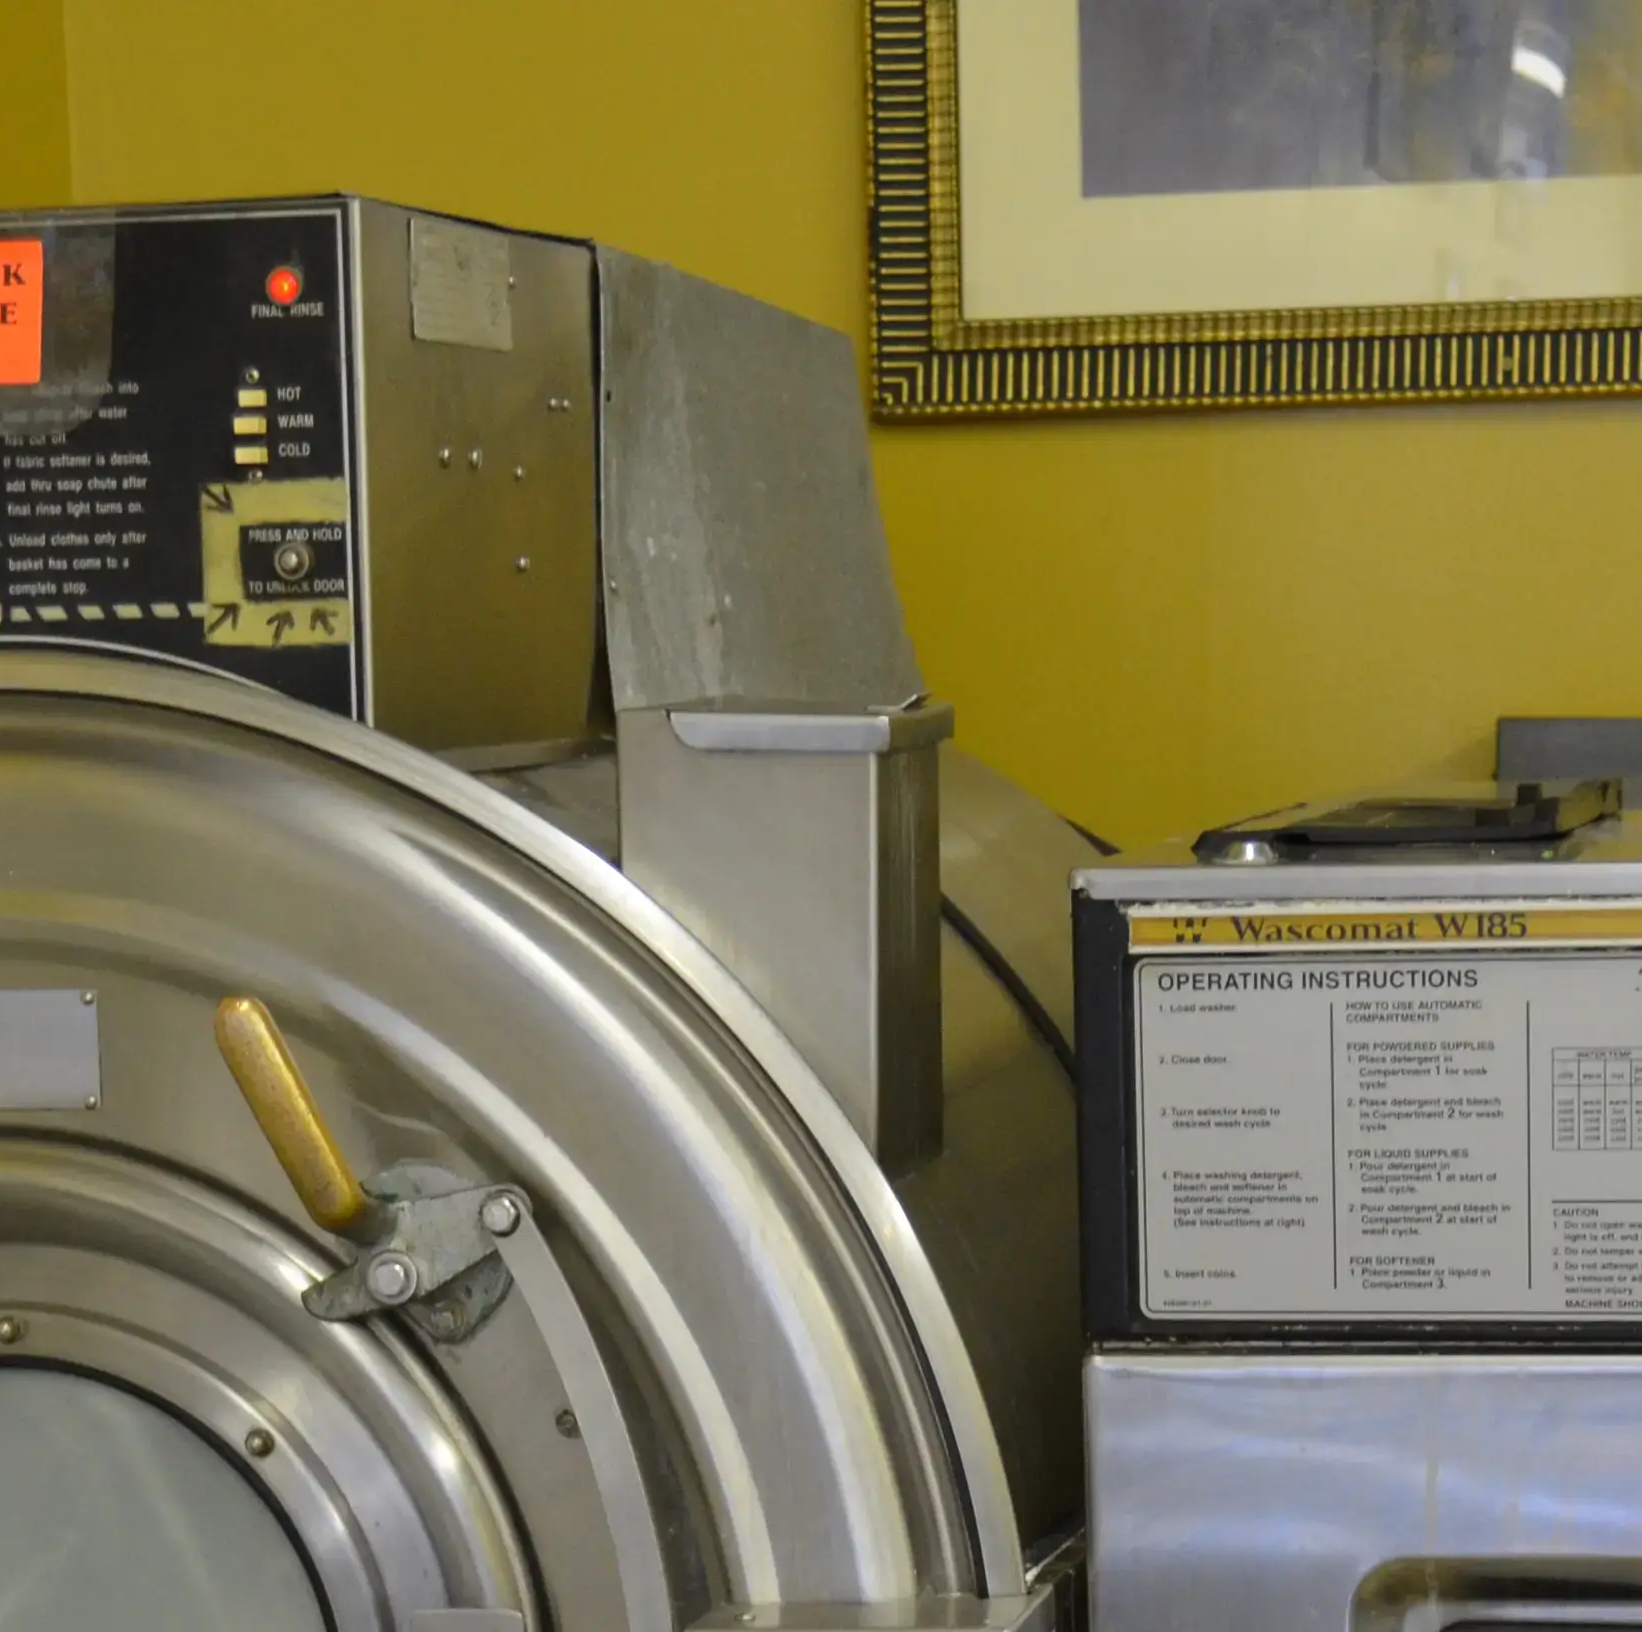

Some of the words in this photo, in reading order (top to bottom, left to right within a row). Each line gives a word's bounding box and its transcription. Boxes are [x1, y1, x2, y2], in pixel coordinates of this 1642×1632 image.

[252, 305, 284, 318] FINAL
[291, 303, 324, 316] RINSE
[277, 387, 301, 400] HOT
[278, 415, 314, 428] WARM
[278, 444, 311, 457] COLD
[49, 454, 91, 468] softener
[96, 453, 105, 466] is
[6, 479, 26, 492] add
[30, 478, 52, 491] thru
[57, 479, 83, 494] soap
[87, 476, 117, 490] chute
[122, 476, 147, 490] after
[7, 502, 31, 515] final
[36, 503, 62, 515] rinse
[67, 501, 91, 518] light
[95, 501, 123, 514] turns
[9, 532, 46, 547] Unload
[51, 532, 89, 546] clothes
[94, 531, 116, 547] only
[122, 531, 147, 544] after
[249, 528, 282, 542] PRESS
[286, 528, 309, 541] AND
[313, 528, 342, 541] HOLD
[9, 558, 43, 571] basket
[48, 557, 67, 570] has
[73, 557, 101, 569] come
[107, 557, 117, 569] to
[9, 582, 57, 596] complete
[249, 581, 263, 593] TO
[314, 579, 345, 592] DOOR
[1230, 914, 1419, 943] Wascomat
[1434, 911, 1528, 939] W185
[1157, 972, 1293, 991] OPERATING
[1301, 969, 1478, 990] INSTRUCTIONS
[1345, 1001, 1373, 1011] HOW
[1392, 1001, 1414, 1010] USE
[1418, 1000, 1482, 1010] AUTOMATIC
[1346, 1012, 1439, 1023] COMPARTMENTS
[1347, 1041, 1369, 1052] FOR
[1373, 1041, 1436, 1051] POWDERED
[1440, 1040, 1495, 1051] SUPPLIES
[1347, 1149, 1371, 1159] FOR
[1374, 1148, 1411, 1159] LIQUID
[1414, 1148, 1469, 1159] SUPPLIES
[1553, 1207, 1599, 1217] CAUTION
[1349, 1256, 1372, 1265] FOR
[1375, 1255, 1435, 1265] SOFTENER
[1565, 1299, 1612, 1308] MACHINE
